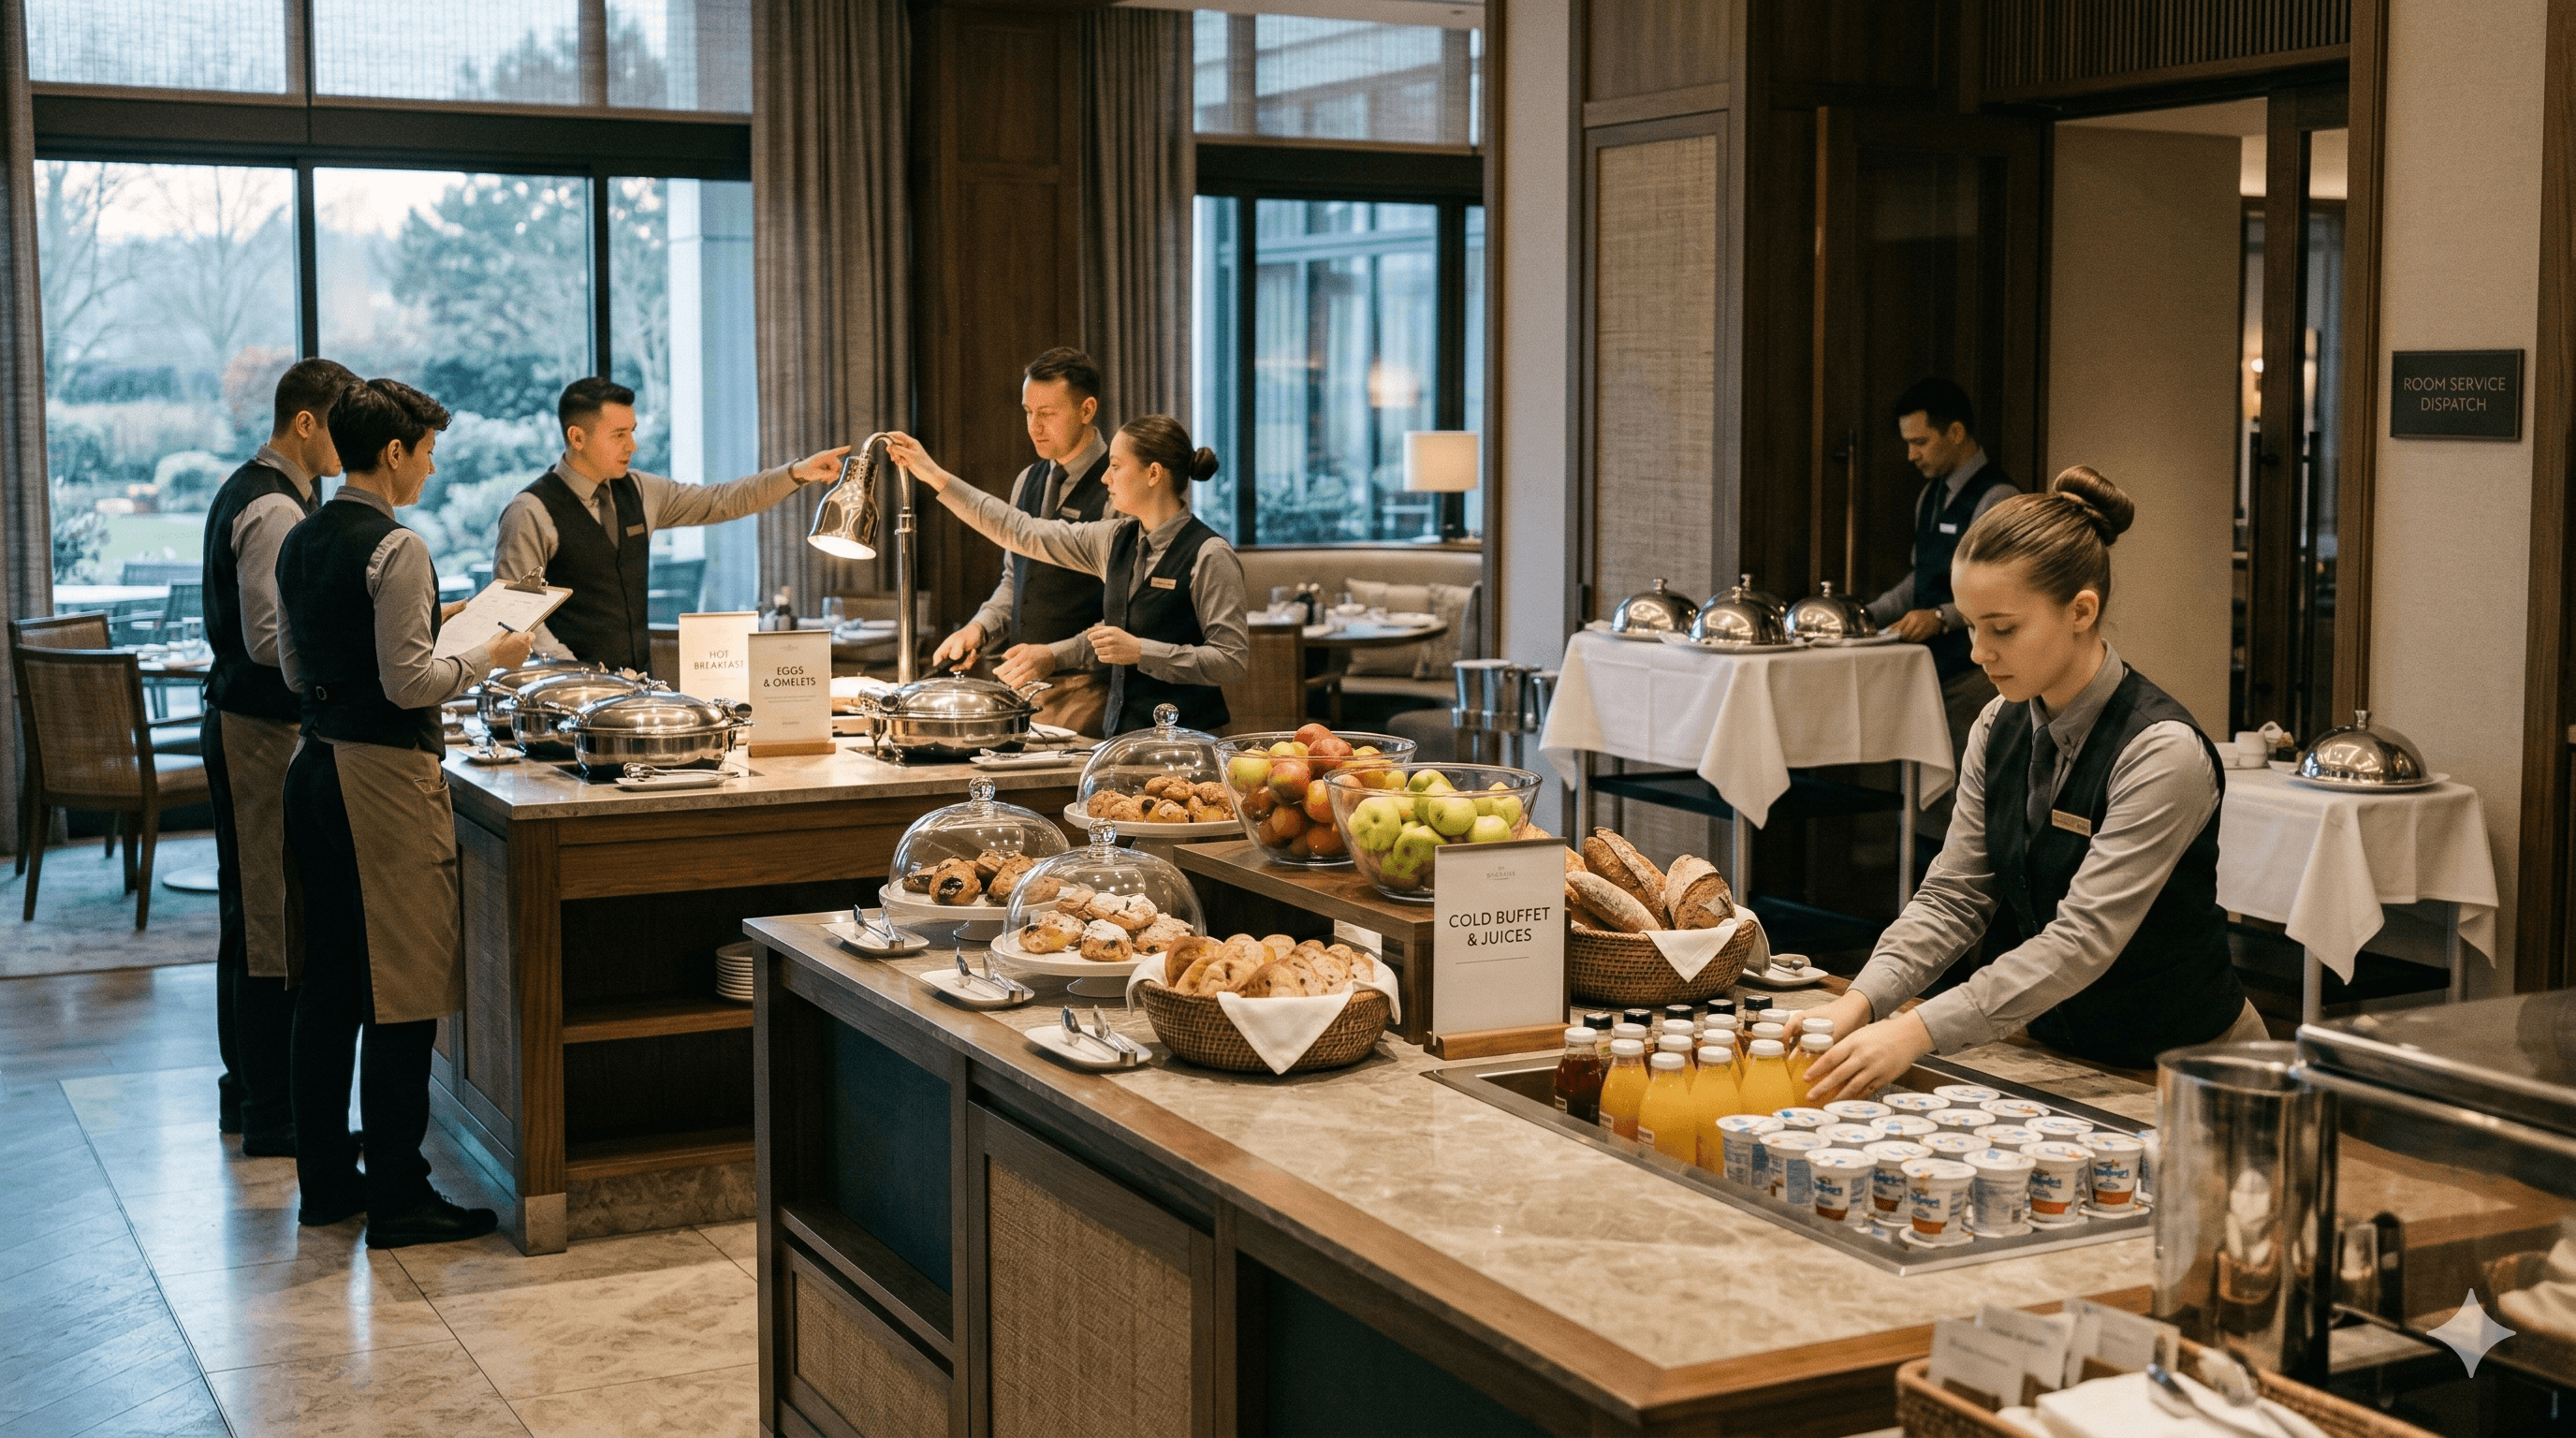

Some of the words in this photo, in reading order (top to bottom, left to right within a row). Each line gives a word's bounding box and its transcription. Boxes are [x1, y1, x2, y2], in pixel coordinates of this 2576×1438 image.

[2404, 376, 2446, 391] ROOM
[2450, 376, 2506, 391] SERVICE
[2421, 397, 2487, 412] DISPATCH
[709, 650, 729, 659] HOT
[694, 660, 744, 670] BREAKFAST
[776, 666, 804, 676] EGGS
[763, 679, 770, 688] &
[772, 677, 816, 687] OMELETS
[1449, 912, 1492, 928] COLD
[1496, 906, 1551, 925] BUFFET
[1467, 932, 1478, 946] &
[1481, 928, 1532, 946] JUICES
